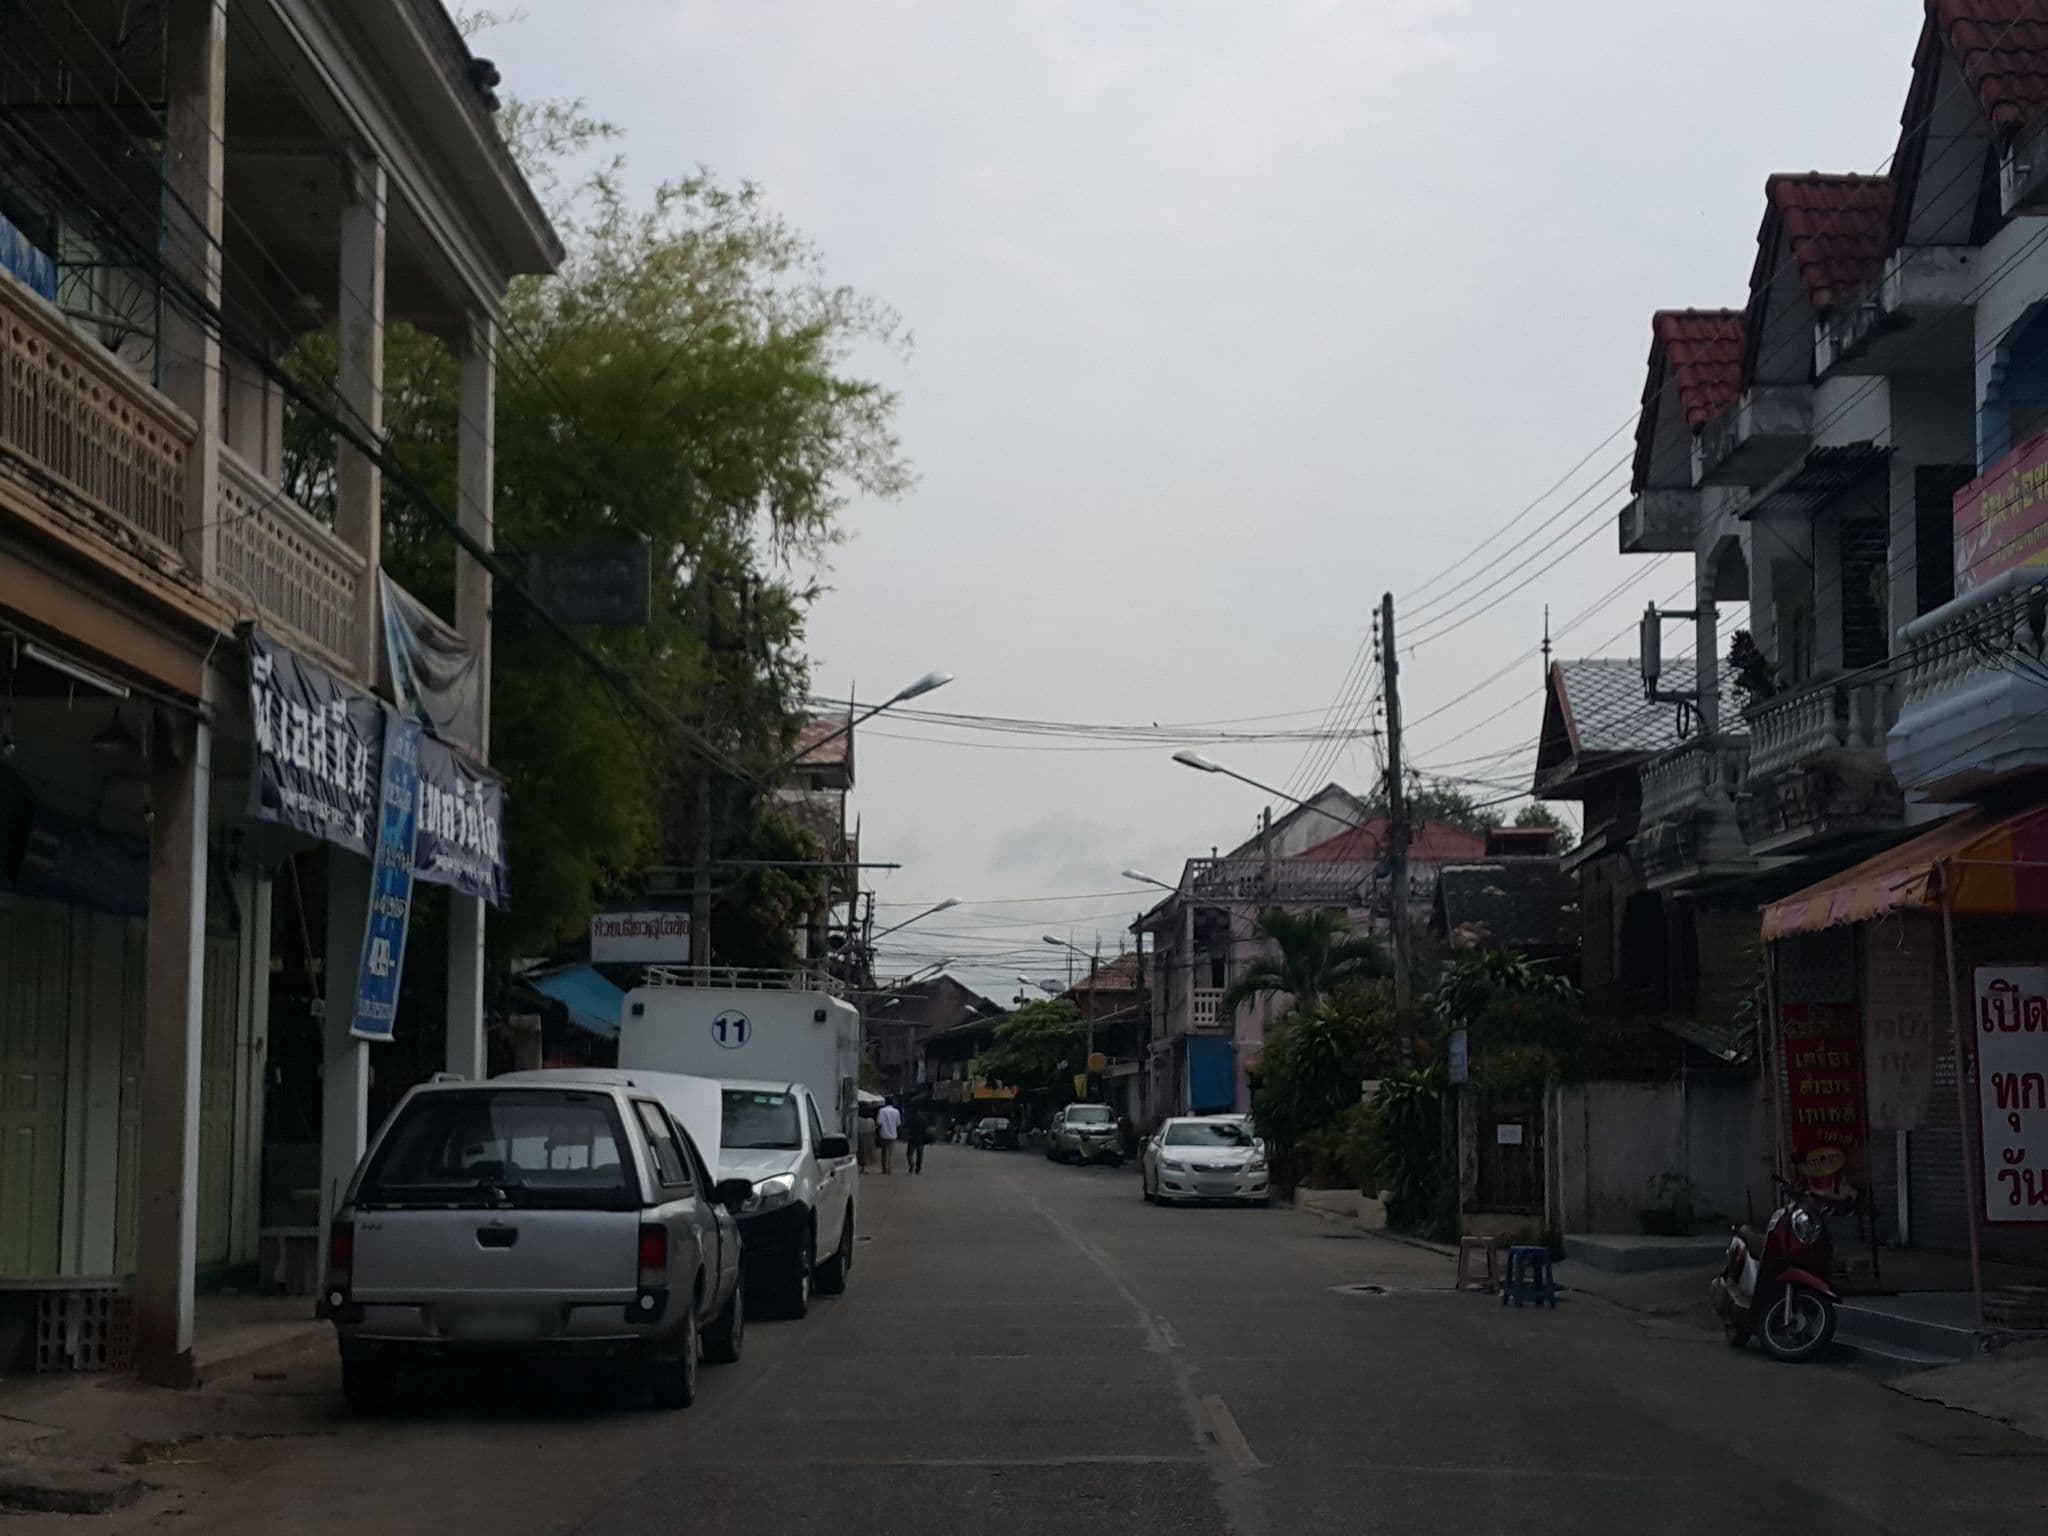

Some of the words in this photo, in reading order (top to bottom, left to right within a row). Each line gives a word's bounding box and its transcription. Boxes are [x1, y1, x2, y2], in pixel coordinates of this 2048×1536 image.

[715, 1018, 745, 1041] 11
[1981, 978, 2048, 1032] เปิด
[1991, 1072, 2046, 1132] ทุก
[1997, 1148, 2048, 1206] วัน
